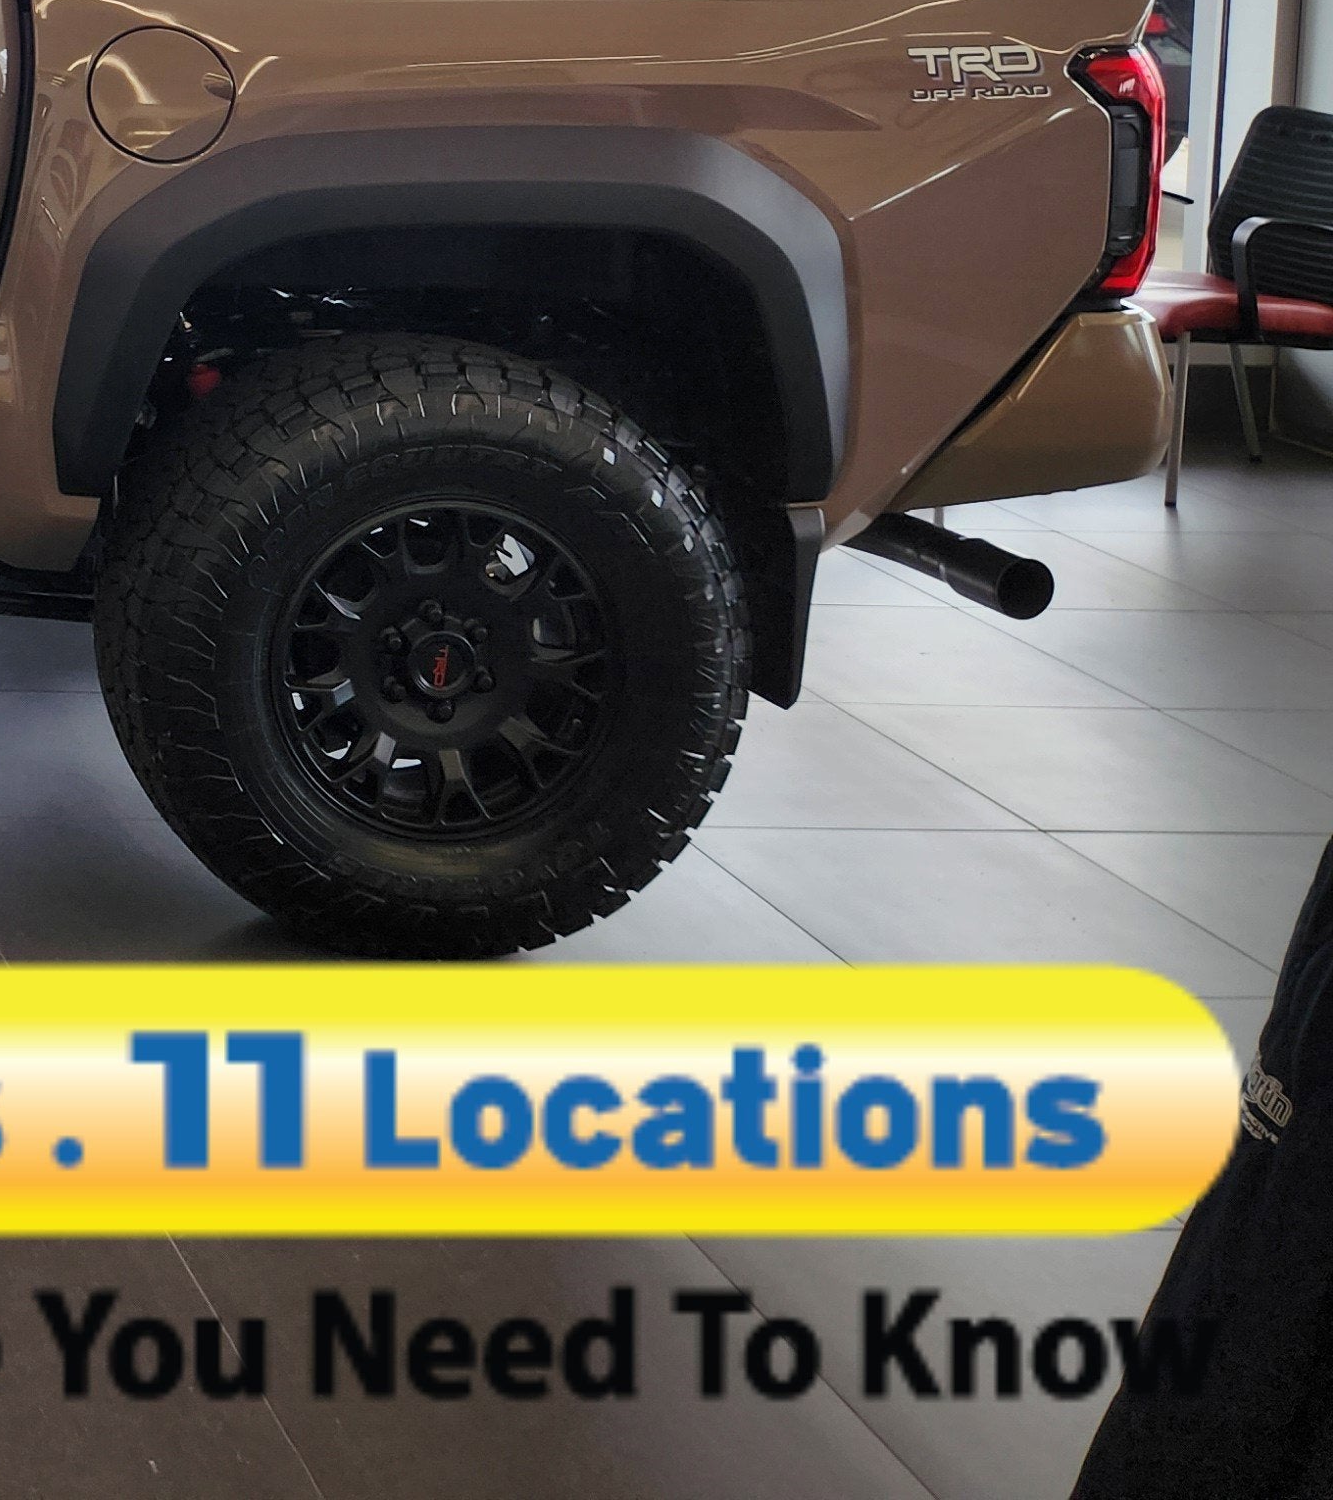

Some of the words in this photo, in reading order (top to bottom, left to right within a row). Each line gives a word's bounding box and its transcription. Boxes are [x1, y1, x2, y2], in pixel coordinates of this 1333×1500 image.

[907, 44, 1040, 84] TRD
[911, 86, 967, 102] OFF
[971, 84, 1052, 101] ROAD
